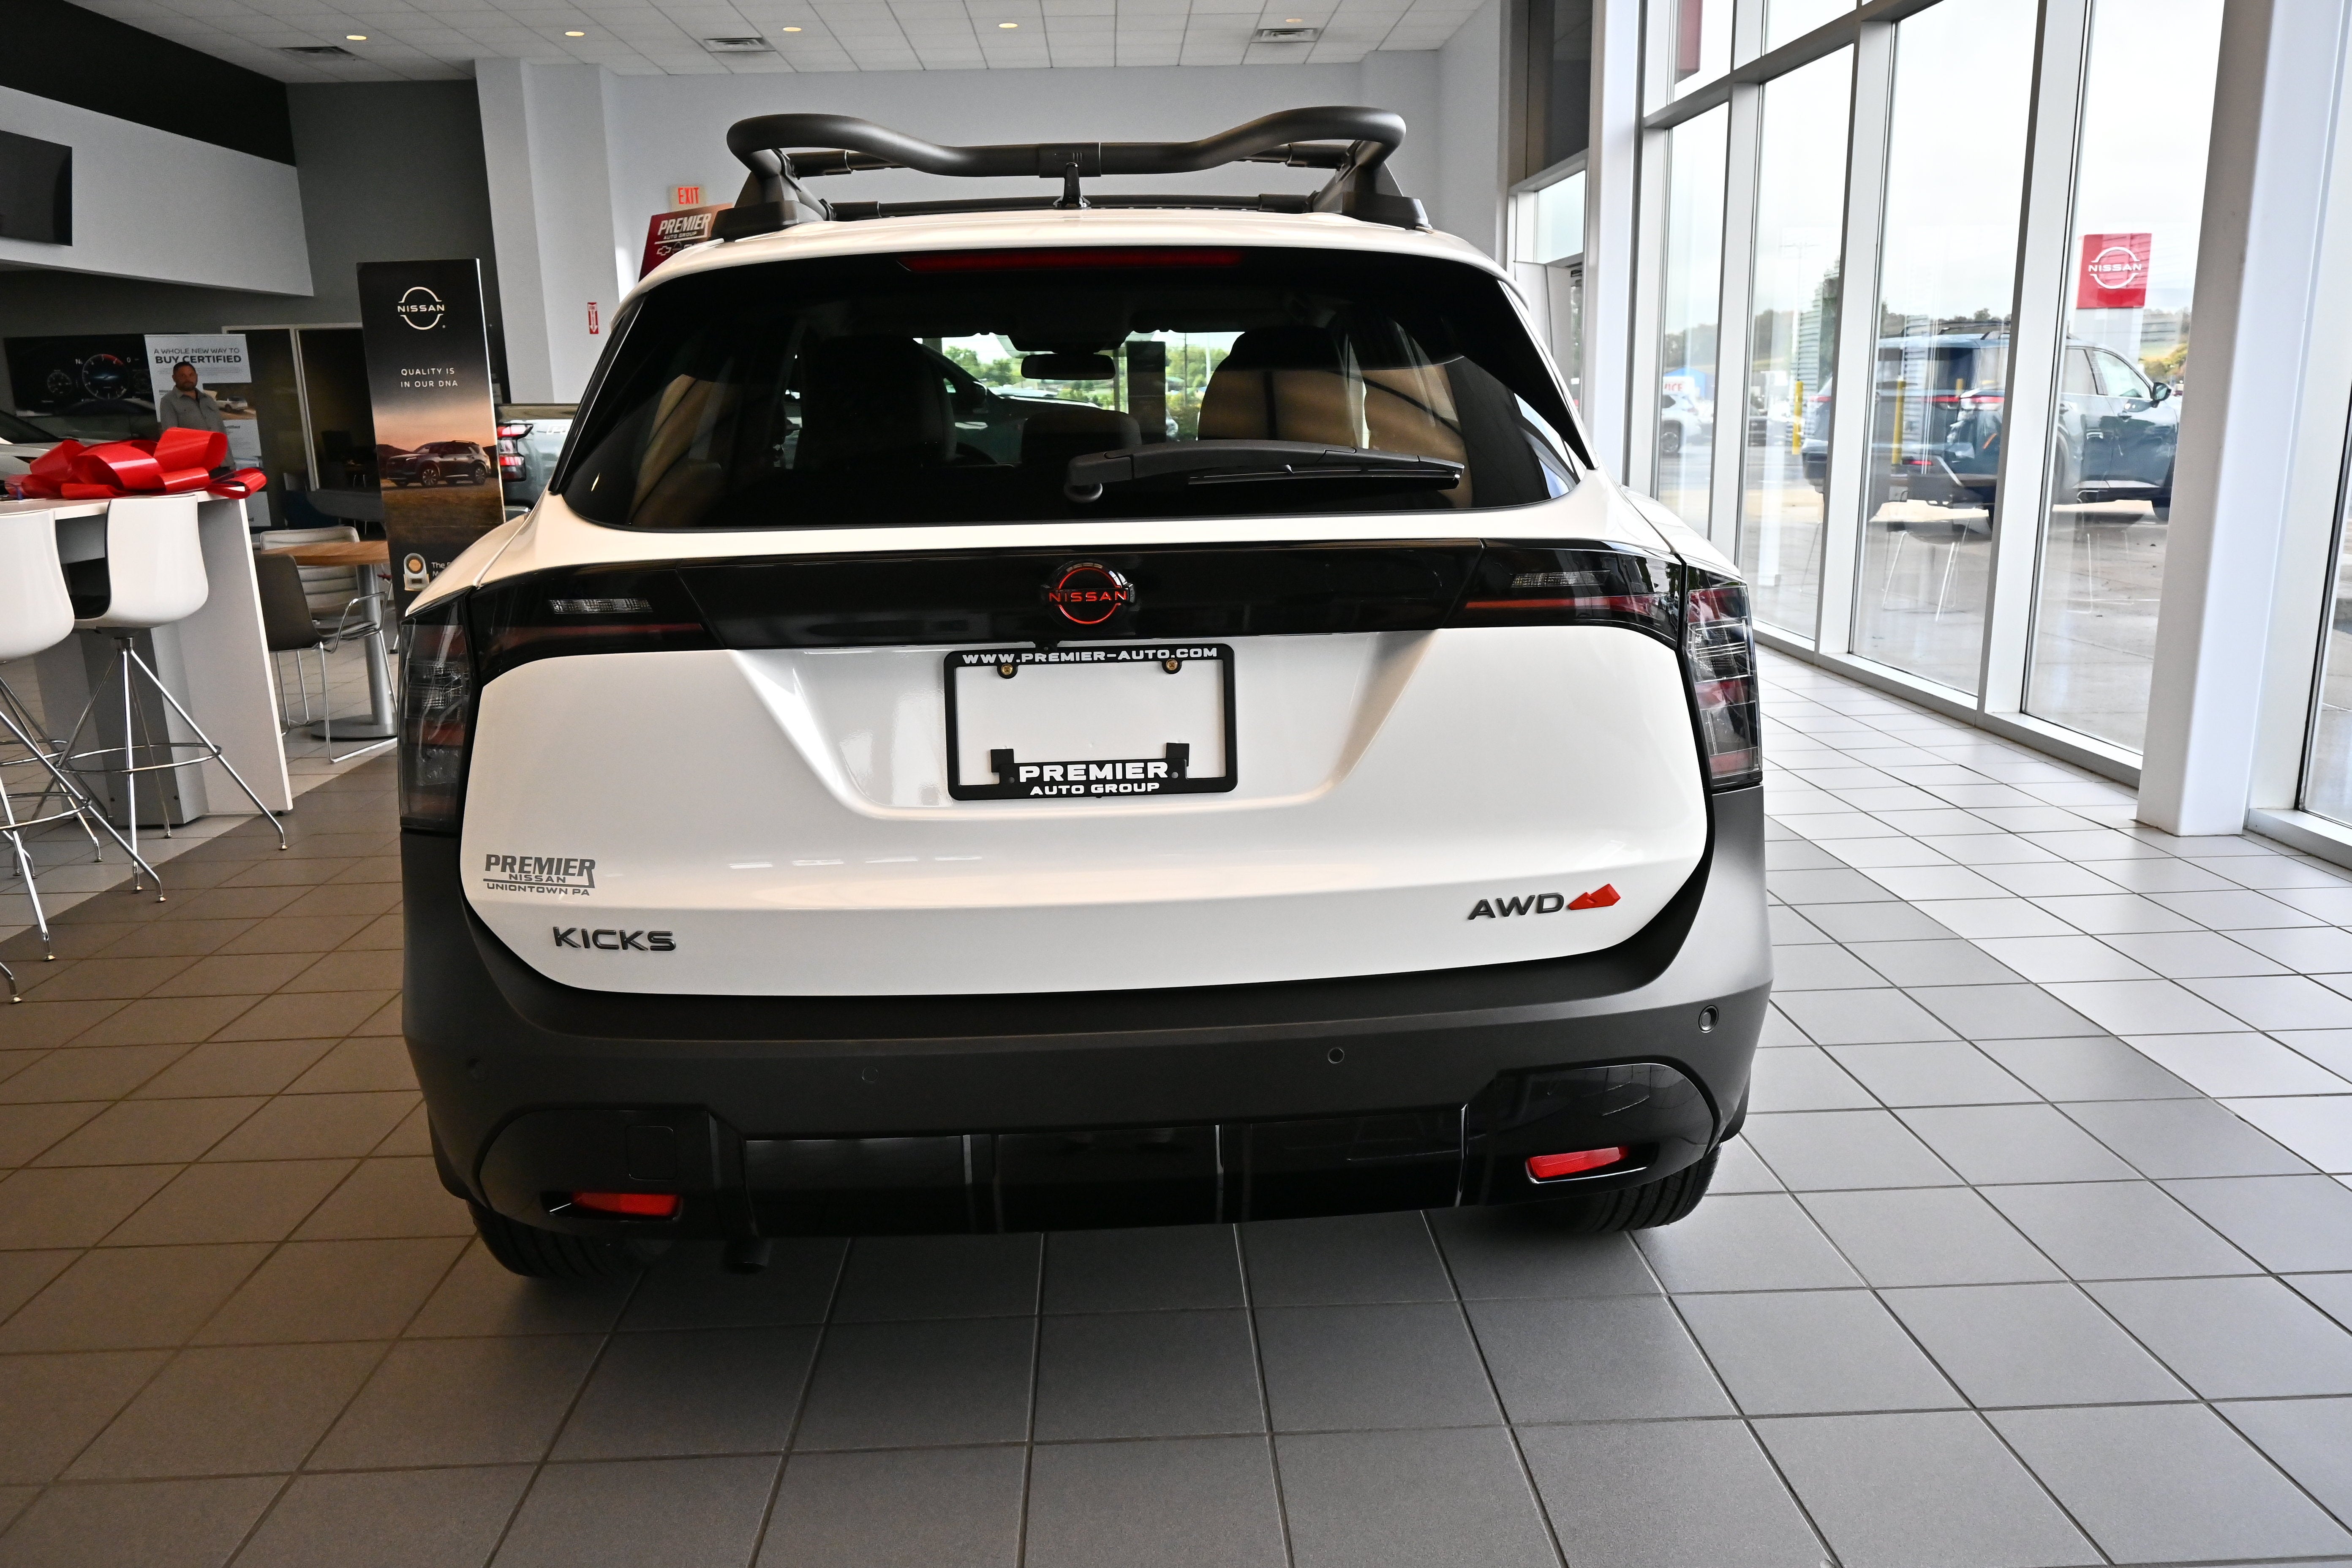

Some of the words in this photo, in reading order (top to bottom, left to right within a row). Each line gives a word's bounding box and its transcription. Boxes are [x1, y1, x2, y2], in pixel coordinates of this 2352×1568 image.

[678, 187, 699, 204] EXIT
[657, 213, 711, 236] PREMIER
[2088, 264, 2142, 272] NISSAN
[397, 304, 445, 312] NISSAN
[401, 368, 442, 376] QUALITY
[1049, 591, 1127, 602] NISSAN
[962, 648, 1217, 664] WWW.PREMIER-AUTO.COM
[1019, 762, 1168, 782] PREMIER
[1030, 785, 1084, 795] AUTO
[1091, 783, 1160, 793] GROUP
[485, 854, 596, 882] PREMIER
[509, 874, 566, 883] NISSAN
[487, 883, 568, 895] UNIONTOWN
[1467, 893, 1565, 920] AWD
[553, 926, 676, 950] KICKS
